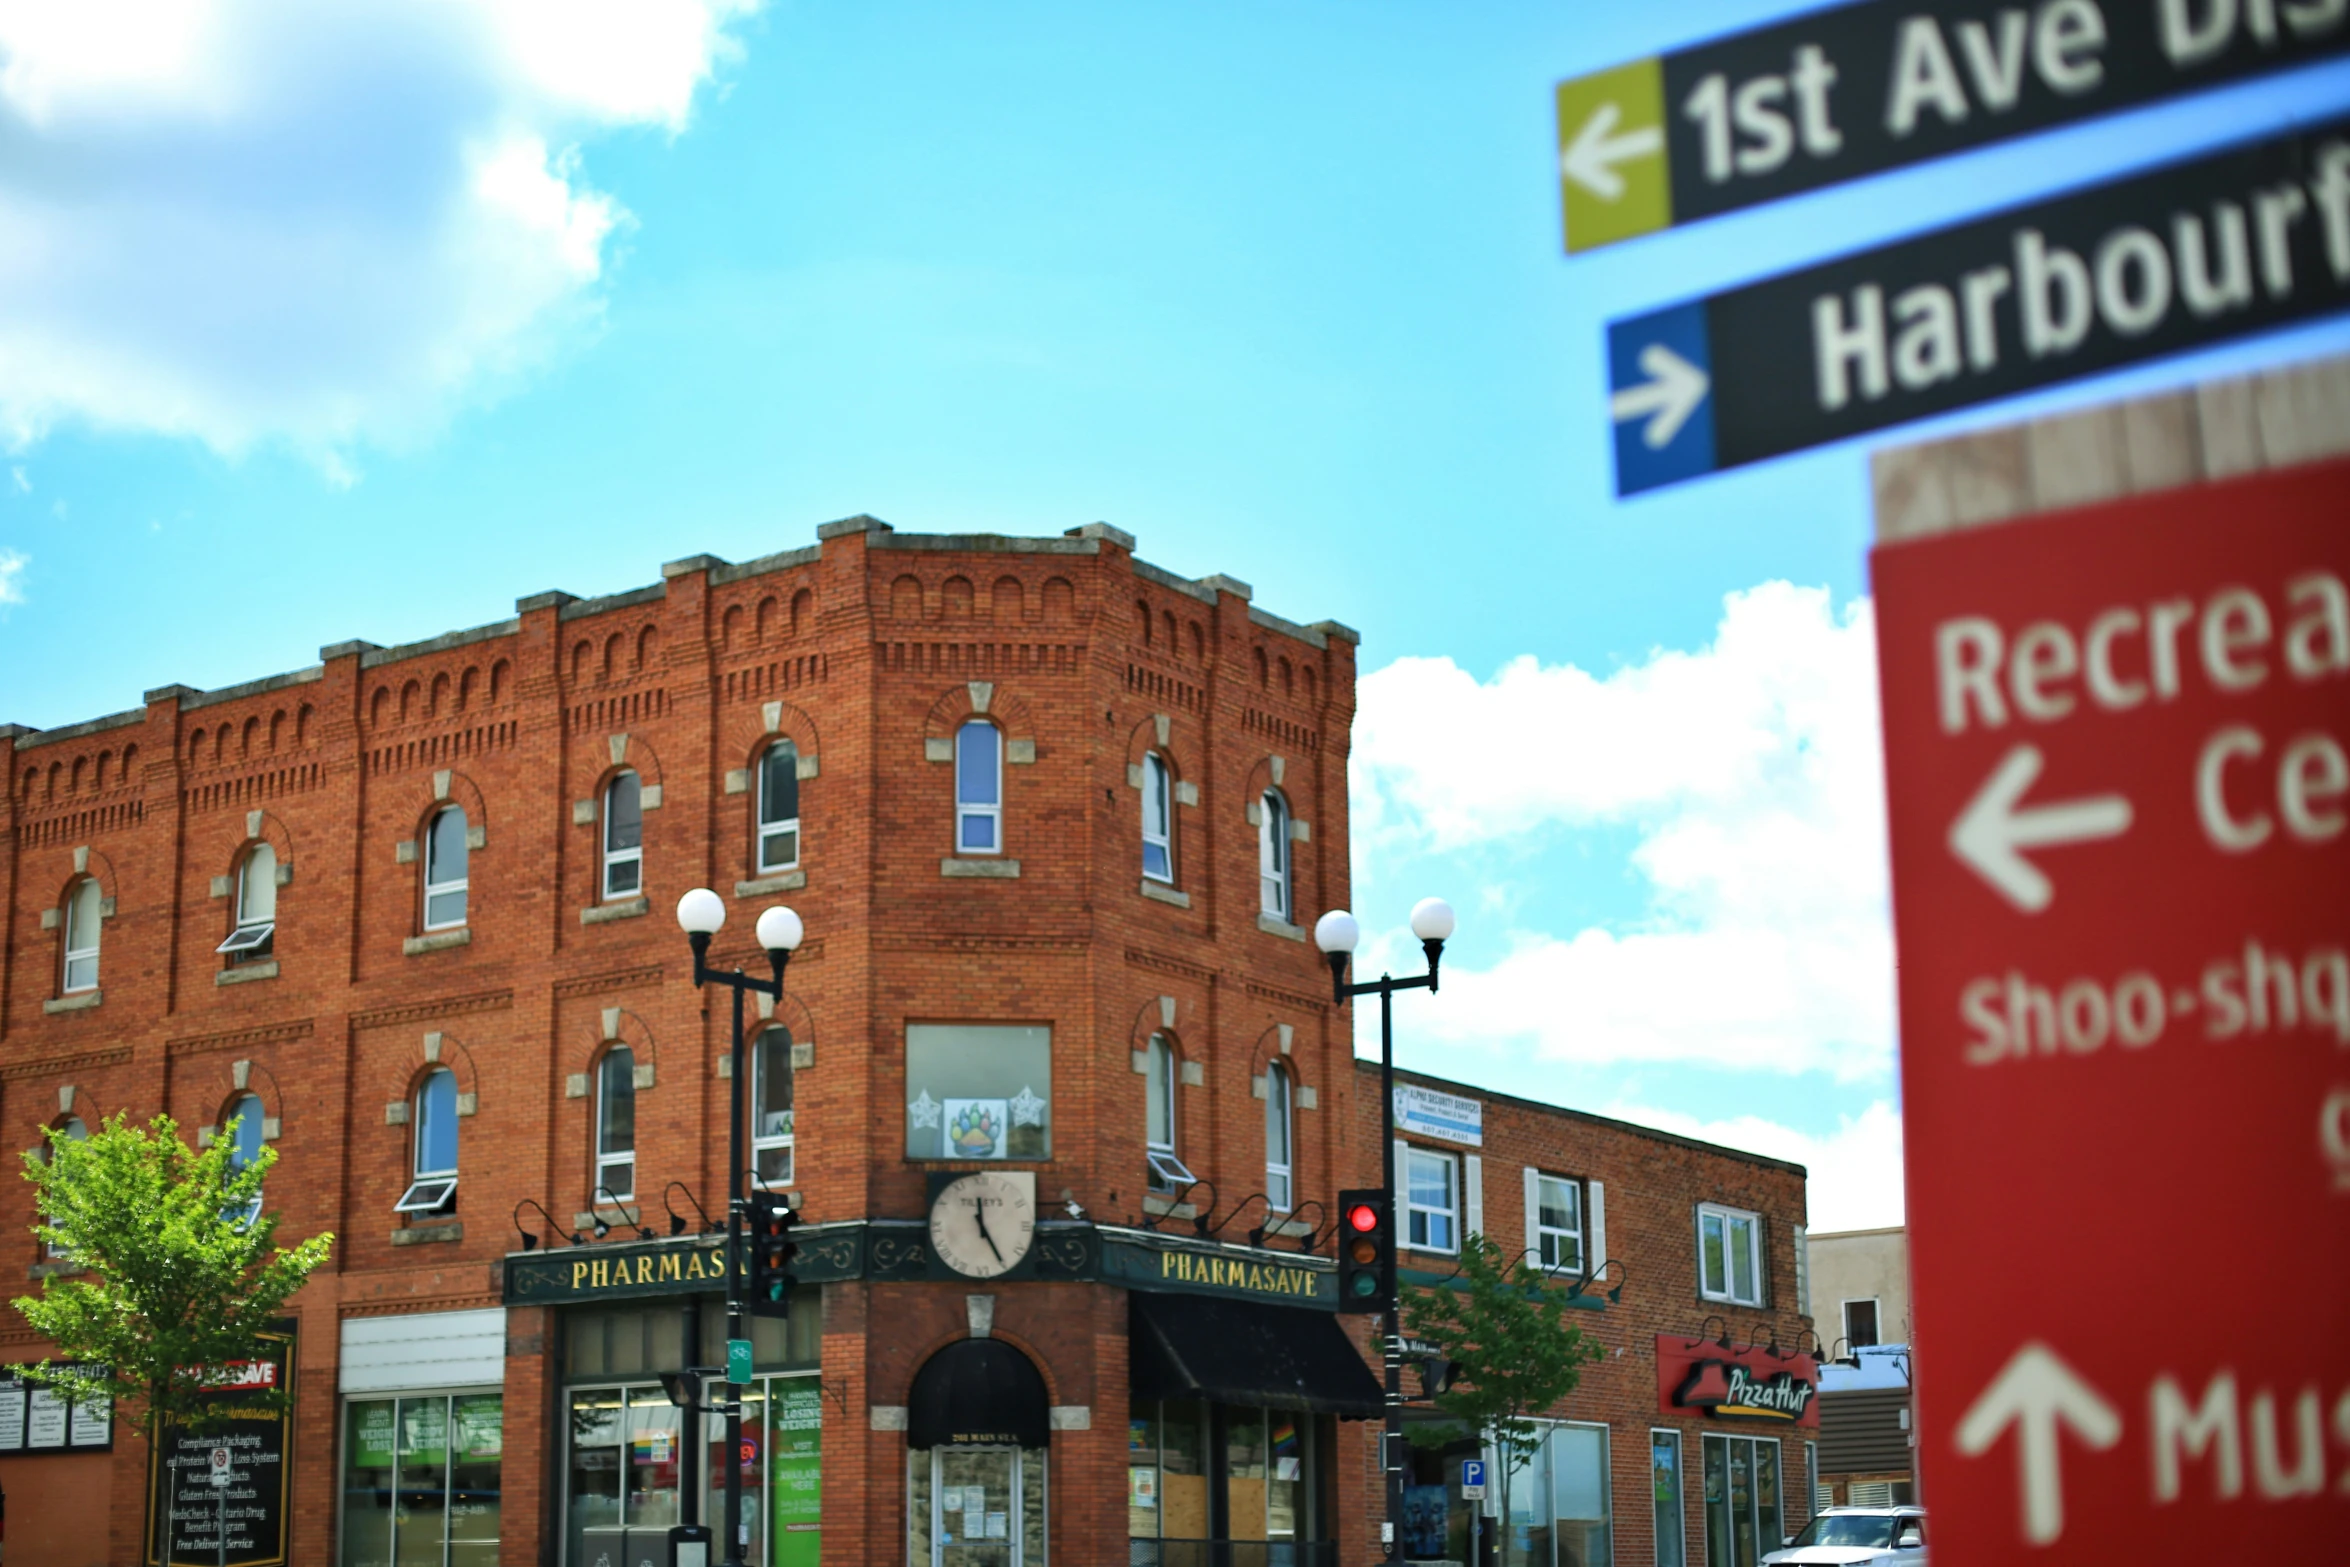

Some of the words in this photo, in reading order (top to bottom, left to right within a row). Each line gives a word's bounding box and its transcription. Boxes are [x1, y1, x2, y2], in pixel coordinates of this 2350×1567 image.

[1684, 45, 1842, 183] 1st
[1887, 0, 2106, 134] Ave
[1935, 571, 2350, 734] Recrea
[2196, 725, 2350, 852] Ce
[1428, 1093, 1453, 1106] SECURITY
[1454, 1099, 1479, 1114] SERVICES
[961, 1198, 1003, 1207] TILEY'S
[571, 1247, 752, 1290] PHARMAS
[1162, 1251, 1318, 1297] PHARMASAVE
[1726, 1368, 1774, 1407] Pizza
[1775, 1376, 1812, 1412] Hut
[178, 1435, 221, 1450] Compliance
[222, 1434, 262, 1448] Packaging
[178, 1455, 207, 1466] Protein
[234, 1453, 251, 1464] Loss
[251, 1452, 280, 1466] System
[187, 1472, 212, 1483] Natura
[1468, 1463, 1480, 1483] P
[178, 1488, 203, 1501] Gluten
[204, 1489, 220, 1500] Free
[215, 1507, 244, 1519] Otario
[245, 1506, 266, 1520] Drug
[184, 1521, 212, 1533] Benefit
[212, 1522, 246, 1534] Prgram
[176, 1539, 192, 1551] Free
[225, 1538, 255, 1549] Service
